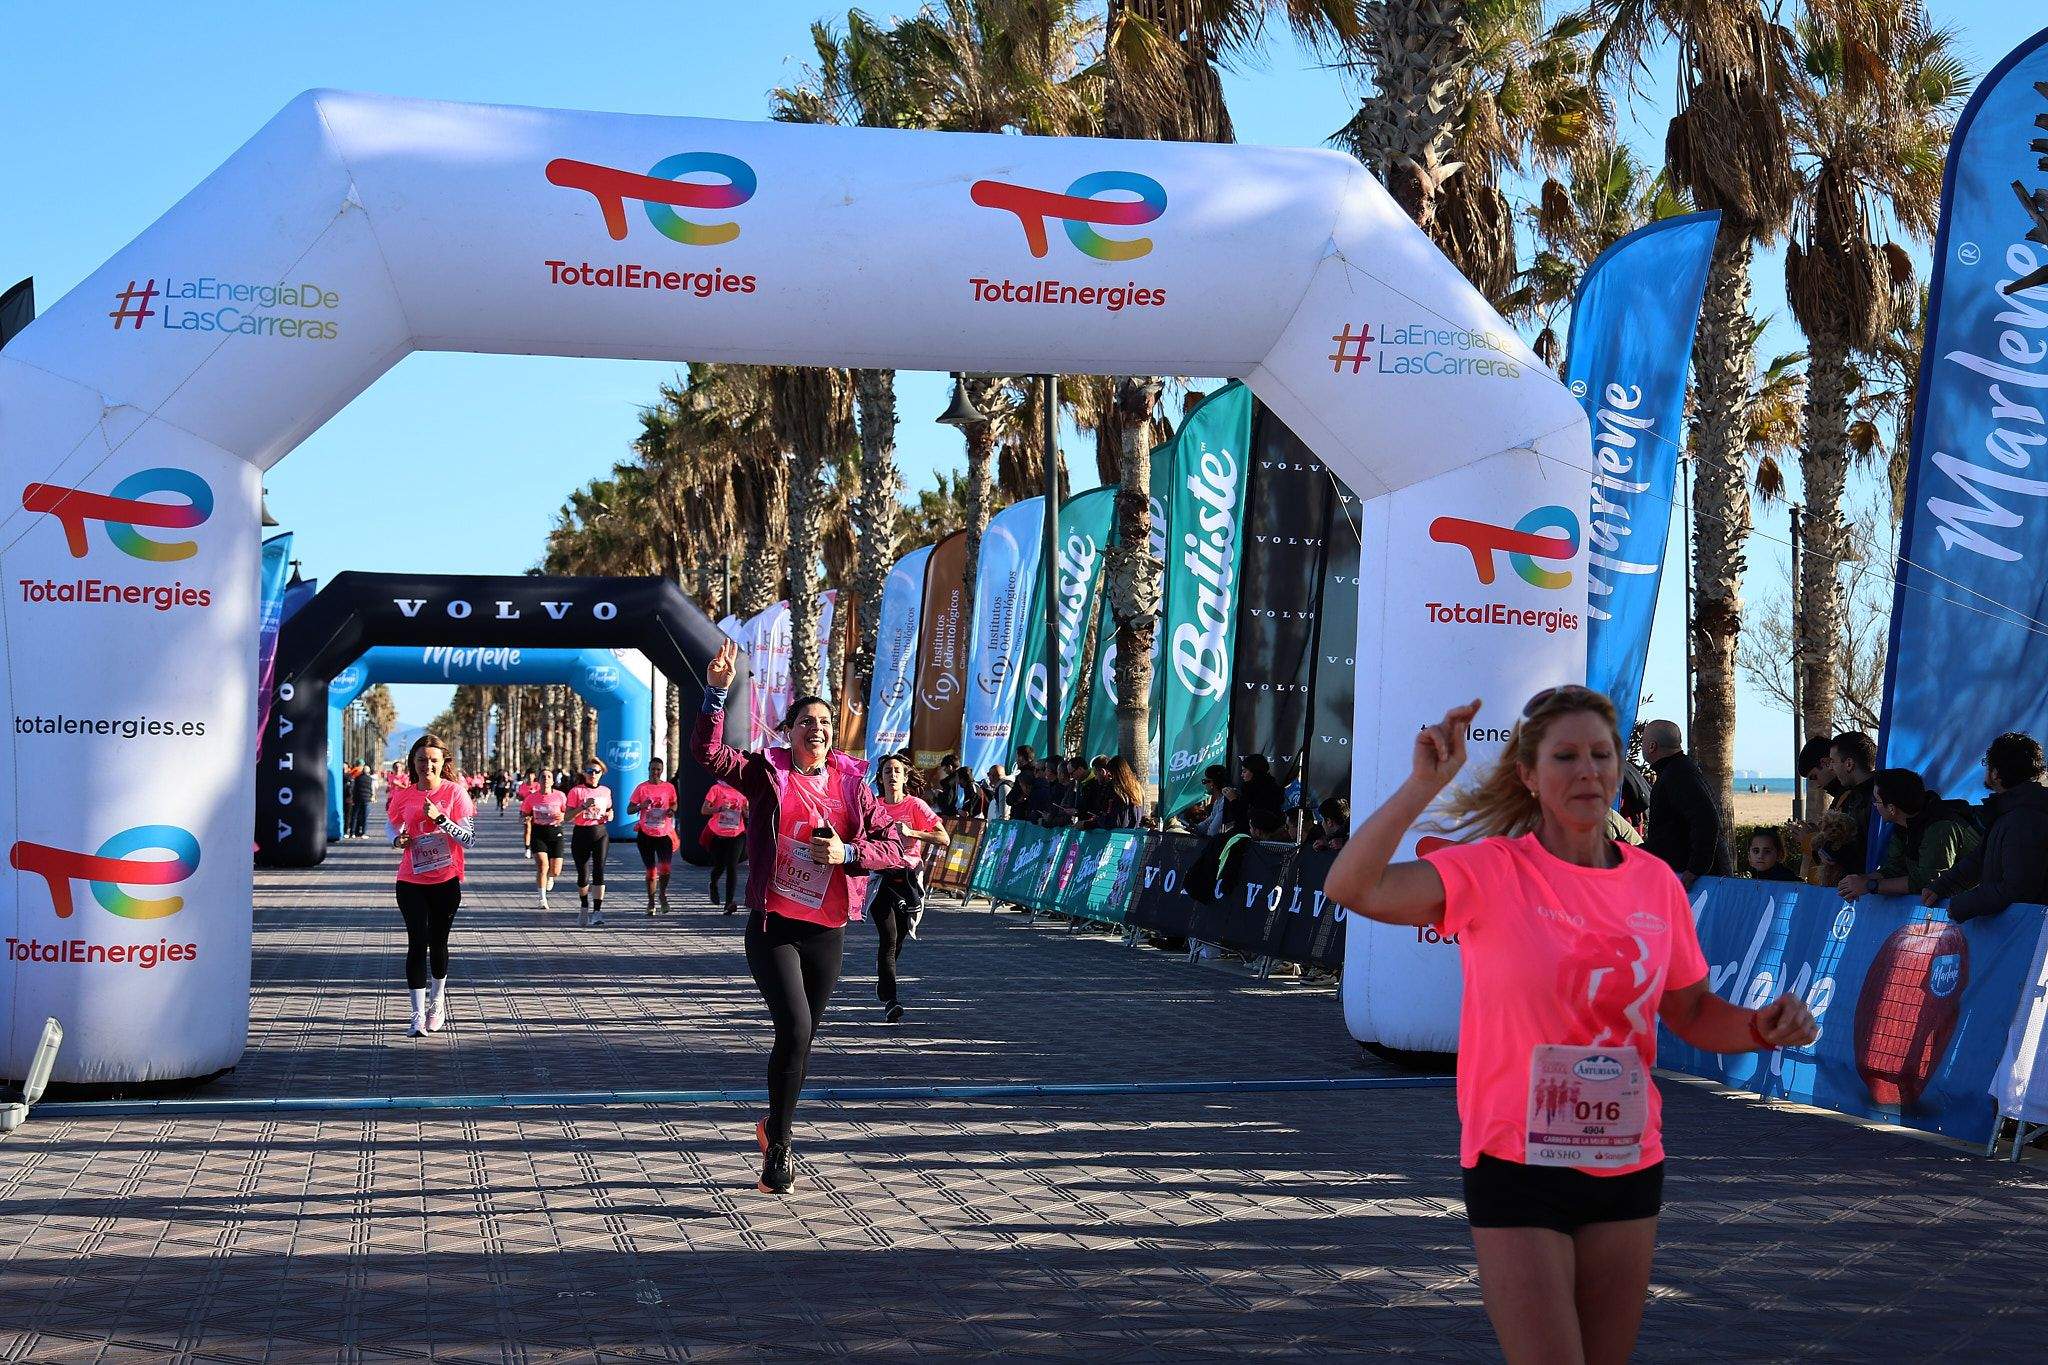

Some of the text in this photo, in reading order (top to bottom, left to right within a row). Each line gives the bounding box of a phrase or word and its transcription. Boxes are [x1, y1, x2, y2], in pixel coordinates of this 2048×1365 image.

[544, 260, 757, 298] TotalEnergies
[969, 278, 1167, 311] TotalEnergies
[163, 307, 338, 340] LasCarreras
[1378, 350, 1521, 379] LasCarreras
[1260, 461, 1328, 472] VOLV
[1172, 448, 1238, 702] Batiste
[19, 579, 211, 612] TotalEnergies
[394, 599, 618, 621] VOLVO
[987, 596, 1002, 650] Institutos
[1425, 603, 1578, 634] TotalEnergies
[931, 614, 945, 667] Institutos
[423, 646, 522, 678] Marlene
[15, 715, 206, 740] totalenergies.es
[279, 683, 295, 843] VOLVO
[787, 866, 812, 882] 016
[5, 938, 197, 969] TotalEnergies
[1575, 1101, 1620, 1121] 016
[1582, 1126, 1605, 1135] 4904
[1540, 1149, 1581, 1160] OYSHO
